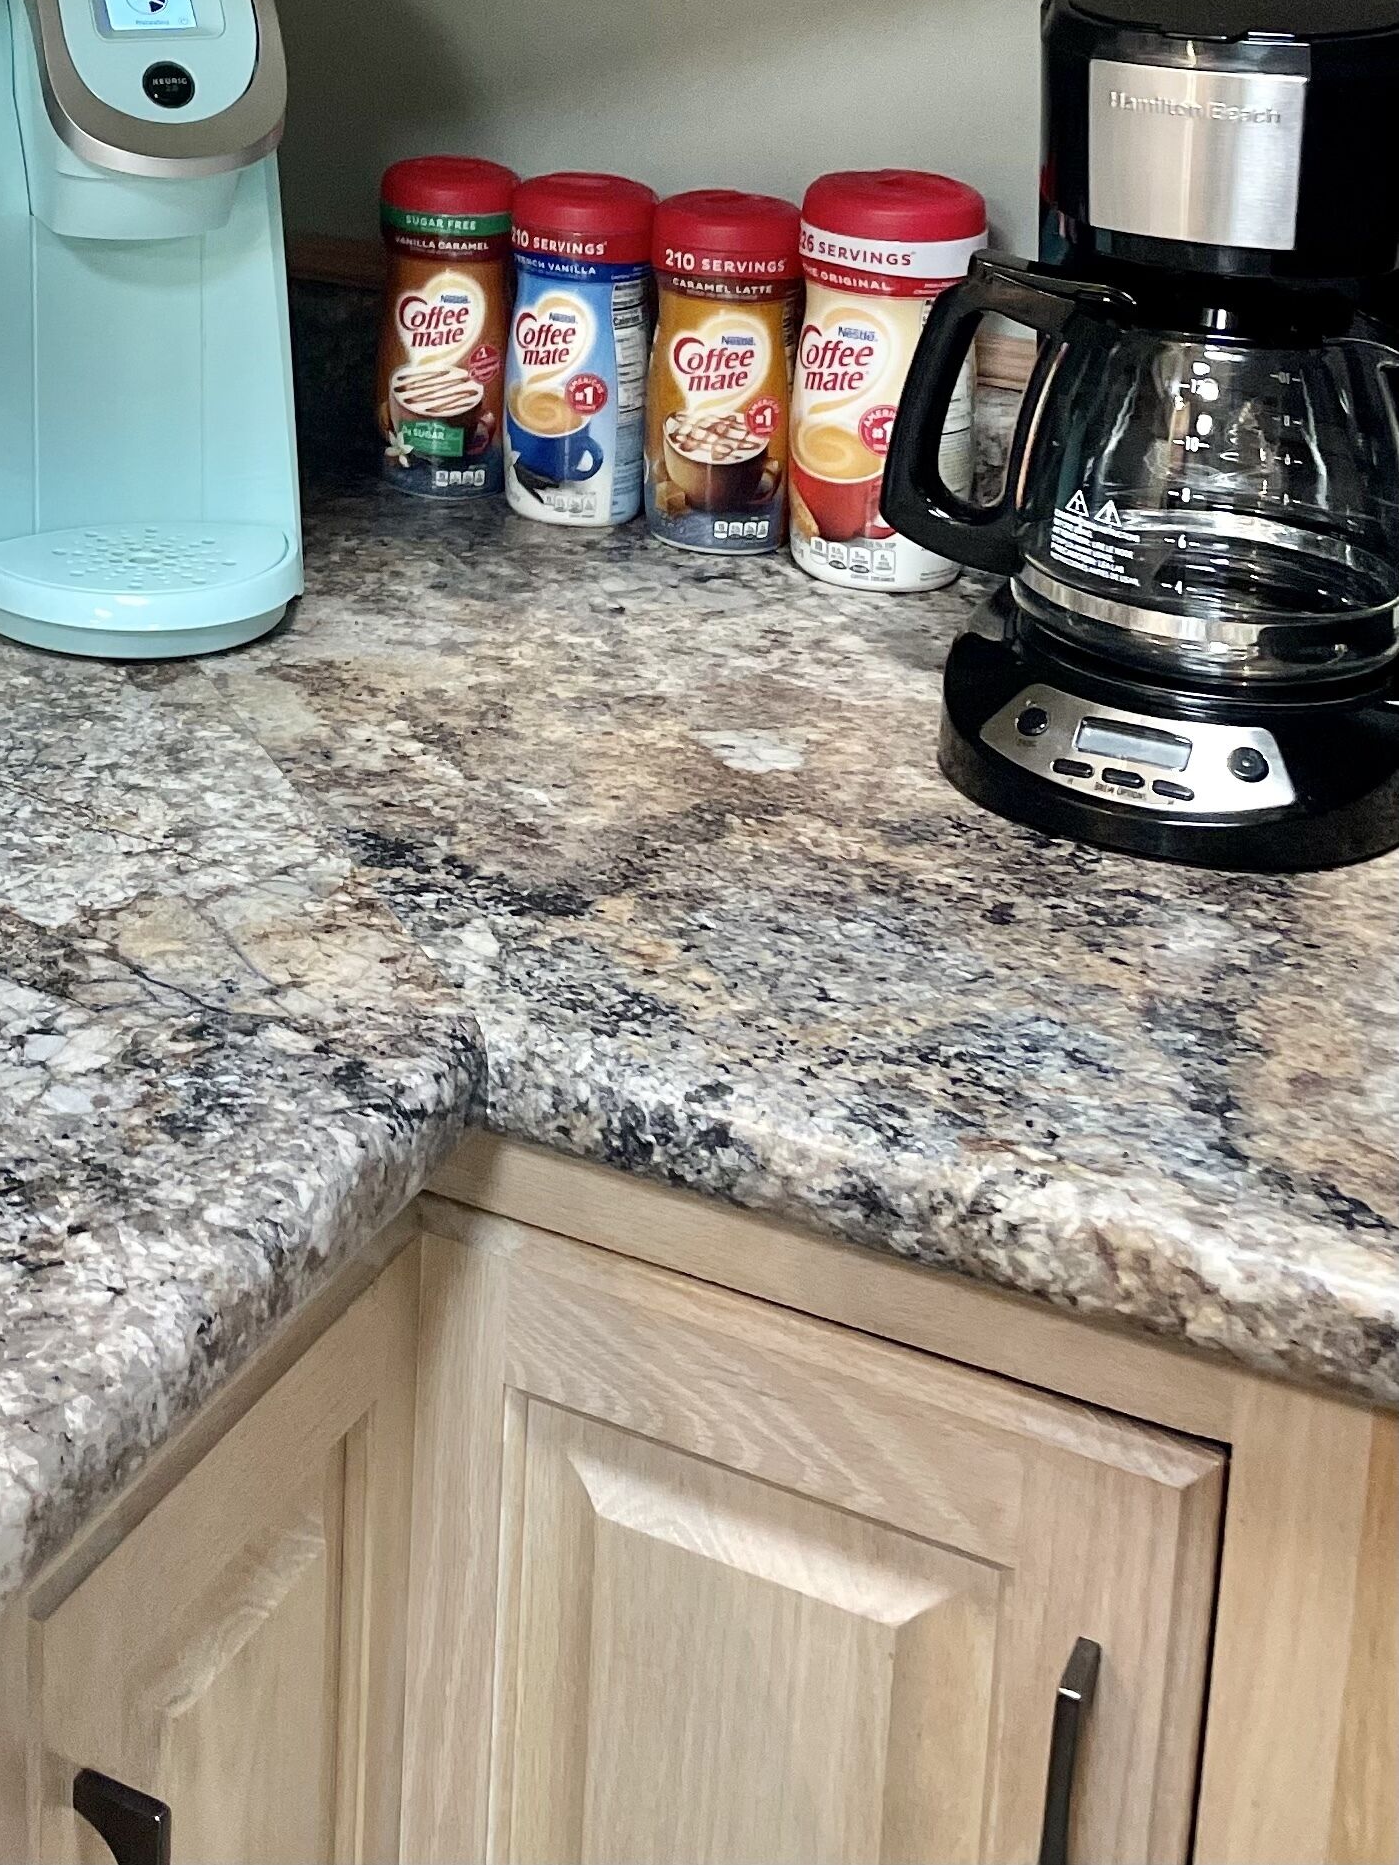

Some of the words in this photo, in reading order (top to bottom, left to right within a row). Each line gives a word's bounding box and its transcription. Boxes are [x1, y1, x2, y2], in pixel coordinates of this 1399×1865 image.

[153, 77, 187, 85] KEURIG
[1111, 92, 1202, 117] Hamilton
[1208, 101, 1281, 124] Beach
[405, 215, 443, 228] SUGAR
[448, 219, 476, 230] FREE
[395, 236, 436, 249] VANILLA
[438, 240, 489, 251] CARAMEL
[533, 236, 605, 255] SERVINGS
[818, 241, 911, 266] SERVINGS
[548, 262, 596, 275] VANILLA
[665, 248, 695, 271] 210
[701, 258, 786, 274] SERVINGS
[673, 277, 730, 293] CARAMEL
[736, 285, 772, 294] LATTE
[820, 271, 891, 291] ORIGINAL
[399, 296, 469, 331] Coffee
[411, 327, 464, 347] mate
[516, 312, 576, 348] Coffee
[523, 347, 569, 365] mate
[674, 337, 754, 375] Coffee
[800, 324, 873, 369] Coffee
[689, 371, 748, 391] mate
[805, 370, 864, 391] mate
